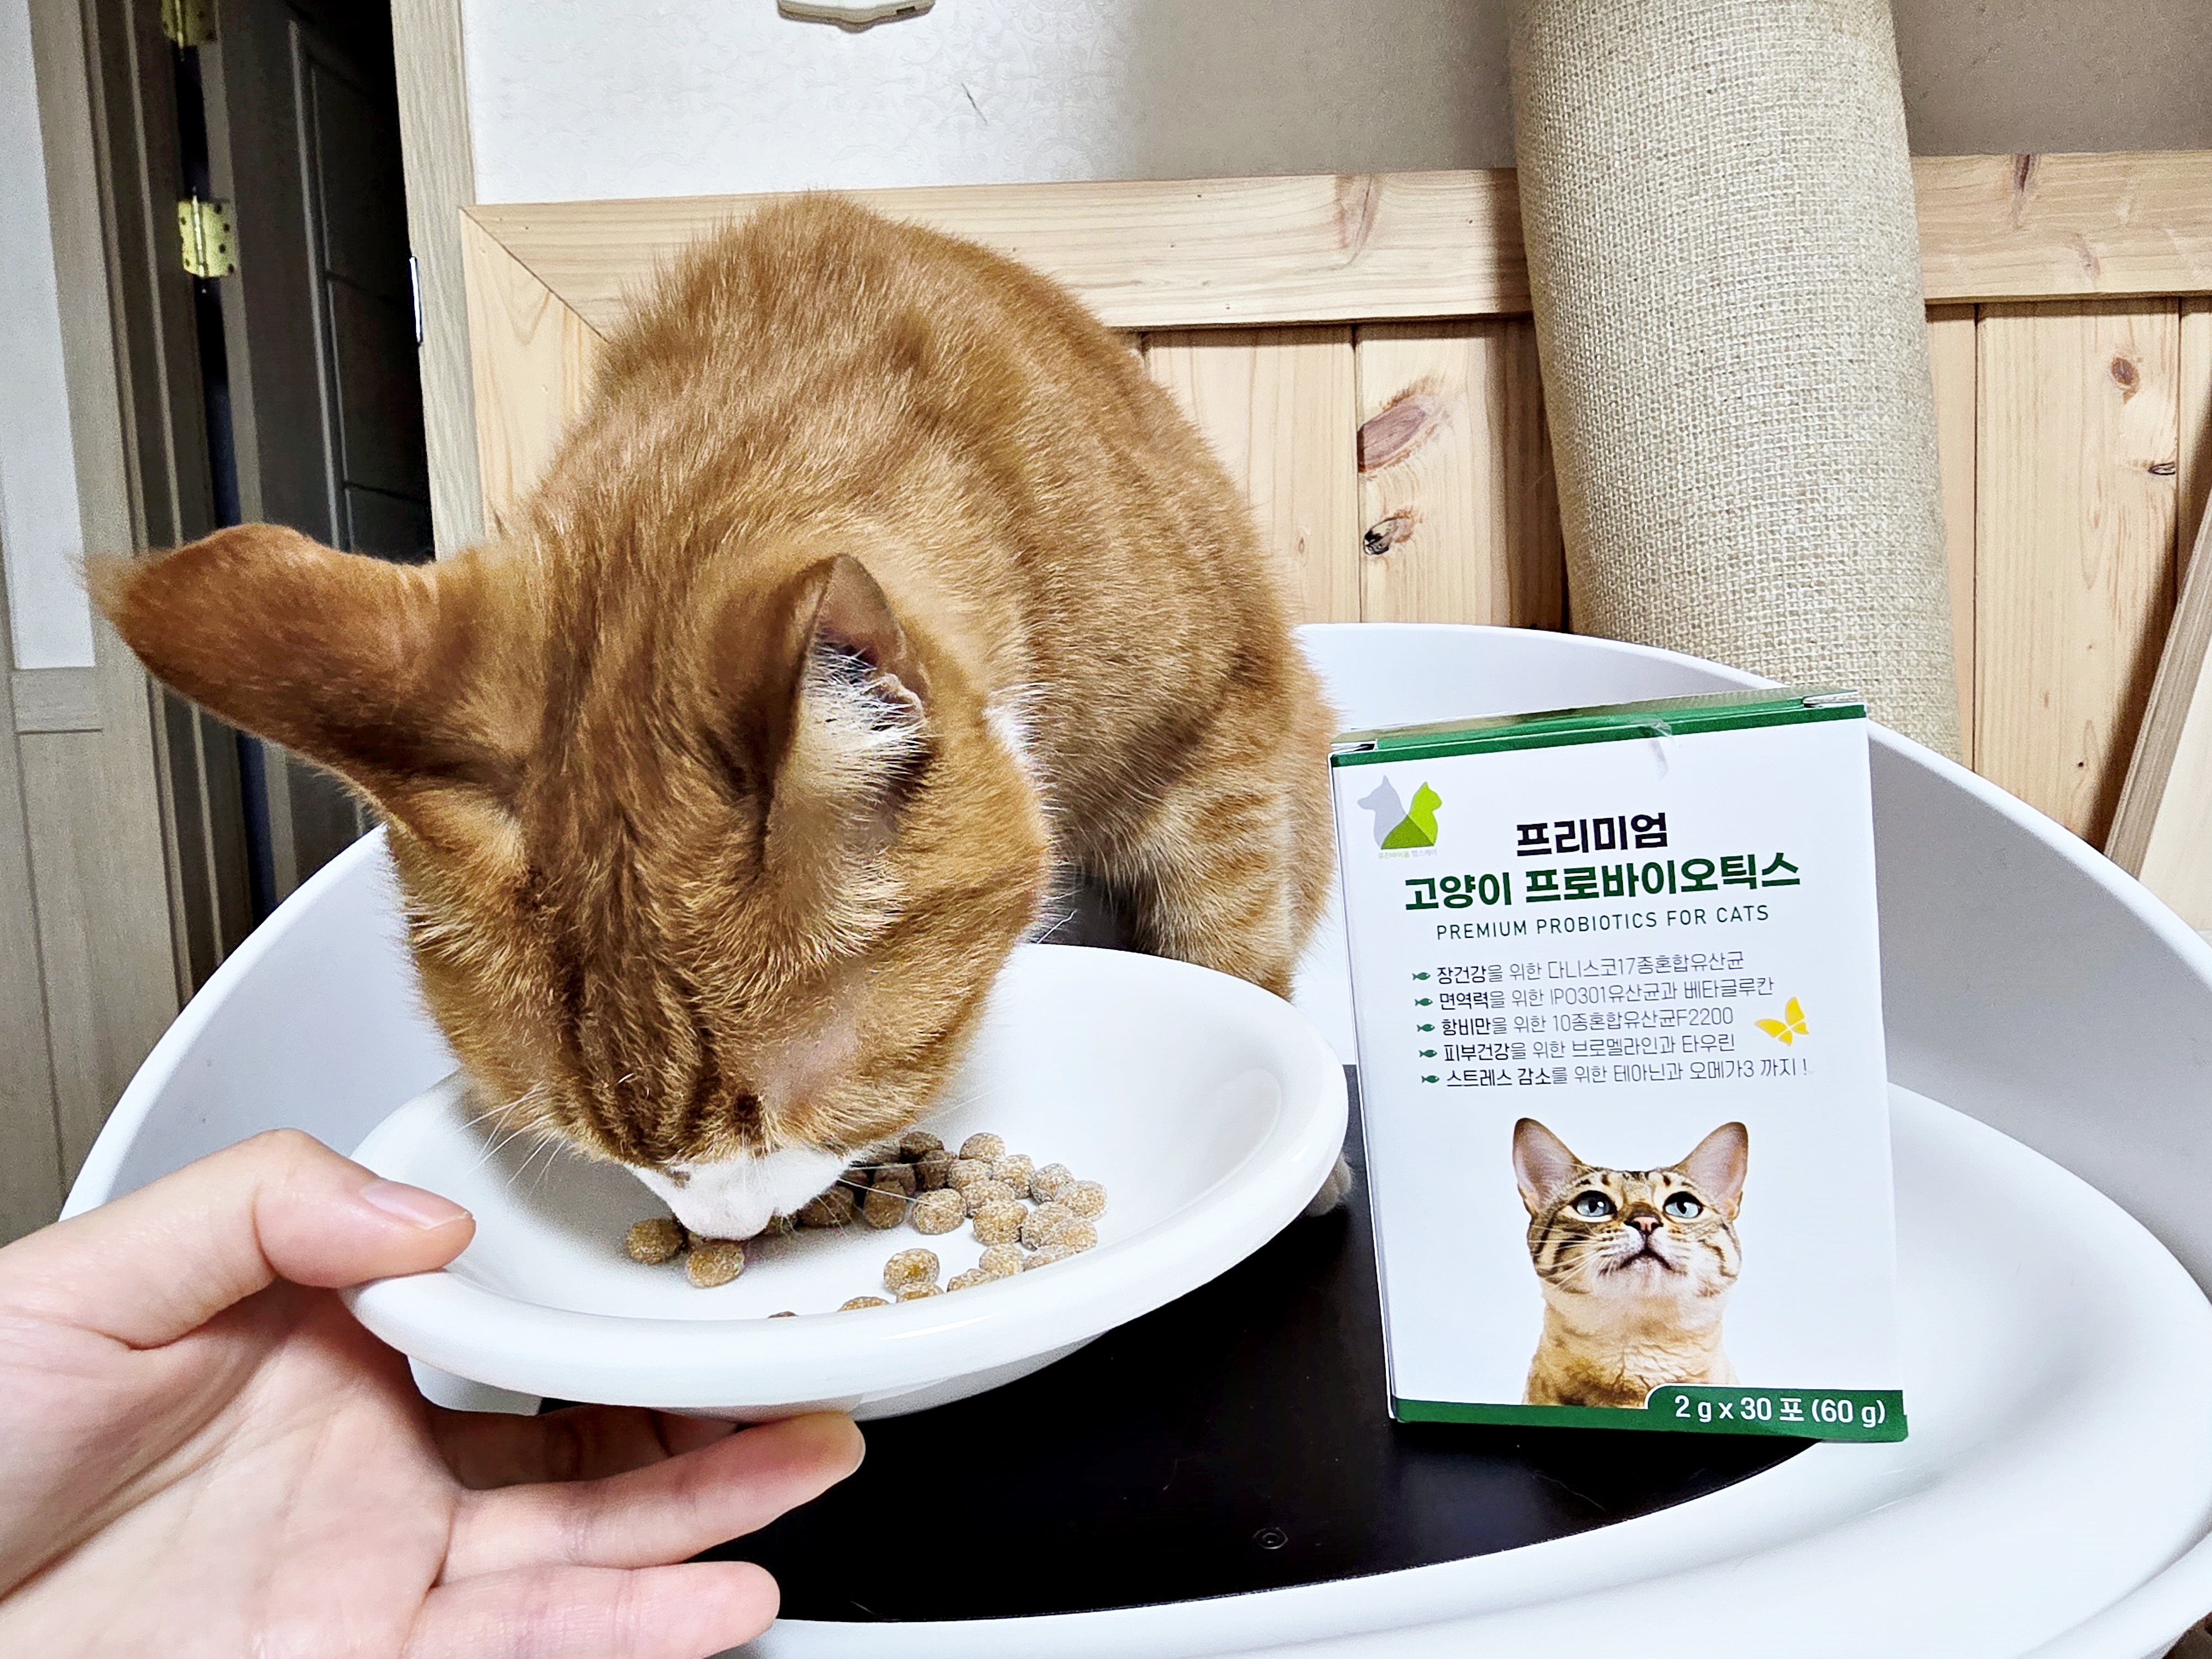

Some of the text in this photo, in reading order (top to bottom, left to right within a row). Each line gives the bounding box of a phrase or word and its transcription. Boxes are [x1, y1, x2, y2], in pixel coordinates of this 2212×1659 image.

[1516, 812, 1668, 857] 프리미엄
[1405, 852, 1801, 910] 고양이 프로바이오틱스
[1437, 905, 1768, 940] PREMIUM PROBIOTICS FOR CATS
[1437, 951, 1744, 984] 장건강을 위한 다니스코17종혼합유산균
[1439, 991, 1505, 1010] 면역력을
[1512, 989, 1544, 1007] 위한
[1684, 977, 1774, 999] 베타글루칸
[1442, 1007, 1733, 1036] 항비만을 위한 10종혼합유산균F2200
[1444, 1034, 1735, 1061] 피부건강을 위한 브로멜라인과 타우린
[1447, 1069, 1512, 1087] 스트레스
[1517, 1067, 1567, 1085] 감소를
[1574, 1066, 1607, 1083] 위한
[1614, 1063, 1683, 1082] 테아닌과
[1690, 1060, 1754, 1079] 오메가3
[1760, 1058, 1796, 1076] 까지
[1675, 1395, 1691, 1417] 2
[1698, 1402, 1711, 1422] g
[1741, 1397, 1771, 1420] 30
[1780, 1398, 1804, 1421] 포
